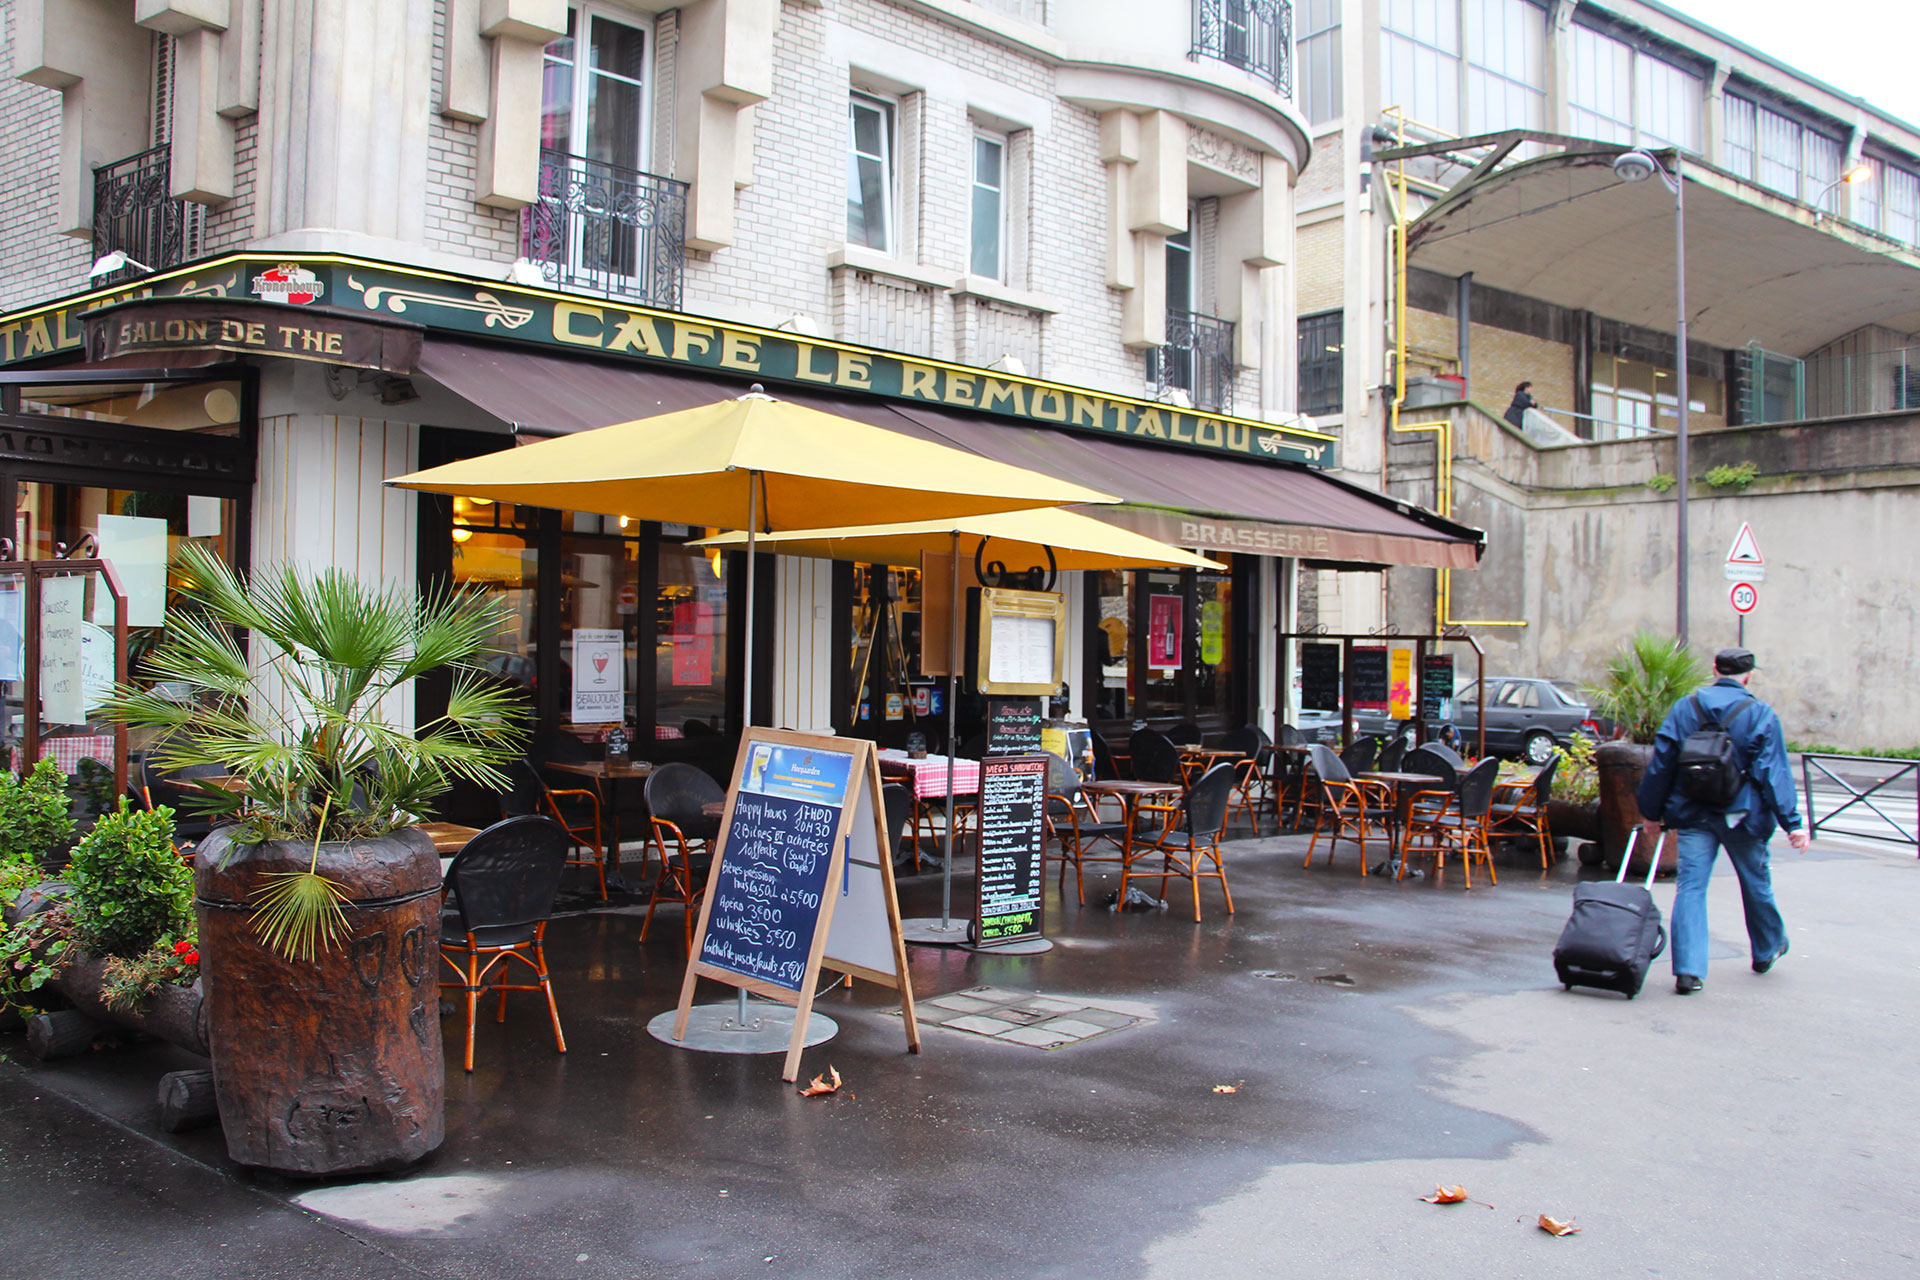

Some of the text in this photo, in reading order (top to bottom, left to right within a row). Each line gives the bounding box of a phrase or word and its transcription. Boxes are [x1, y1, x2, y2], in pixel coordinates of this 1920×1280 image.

[252, 276, 324, 299] Kronenbourg
[119, 320, 344, 355] SALON DE THE
[553, 301, 1250, 453] CAFE LE REMONTALOU
[1180, 521, 1329, 553] BRASSERIE
[1736, 590, 1753, 604] 30
[576, 693, 621, 705] BEAUJOLAIS
[791, 763, 821, 776] Hoegaarden
[985, 763, 1009, 774] MEGA
[735, 794, 762, 825] Happy
[733, 821, 741, 840] 2
